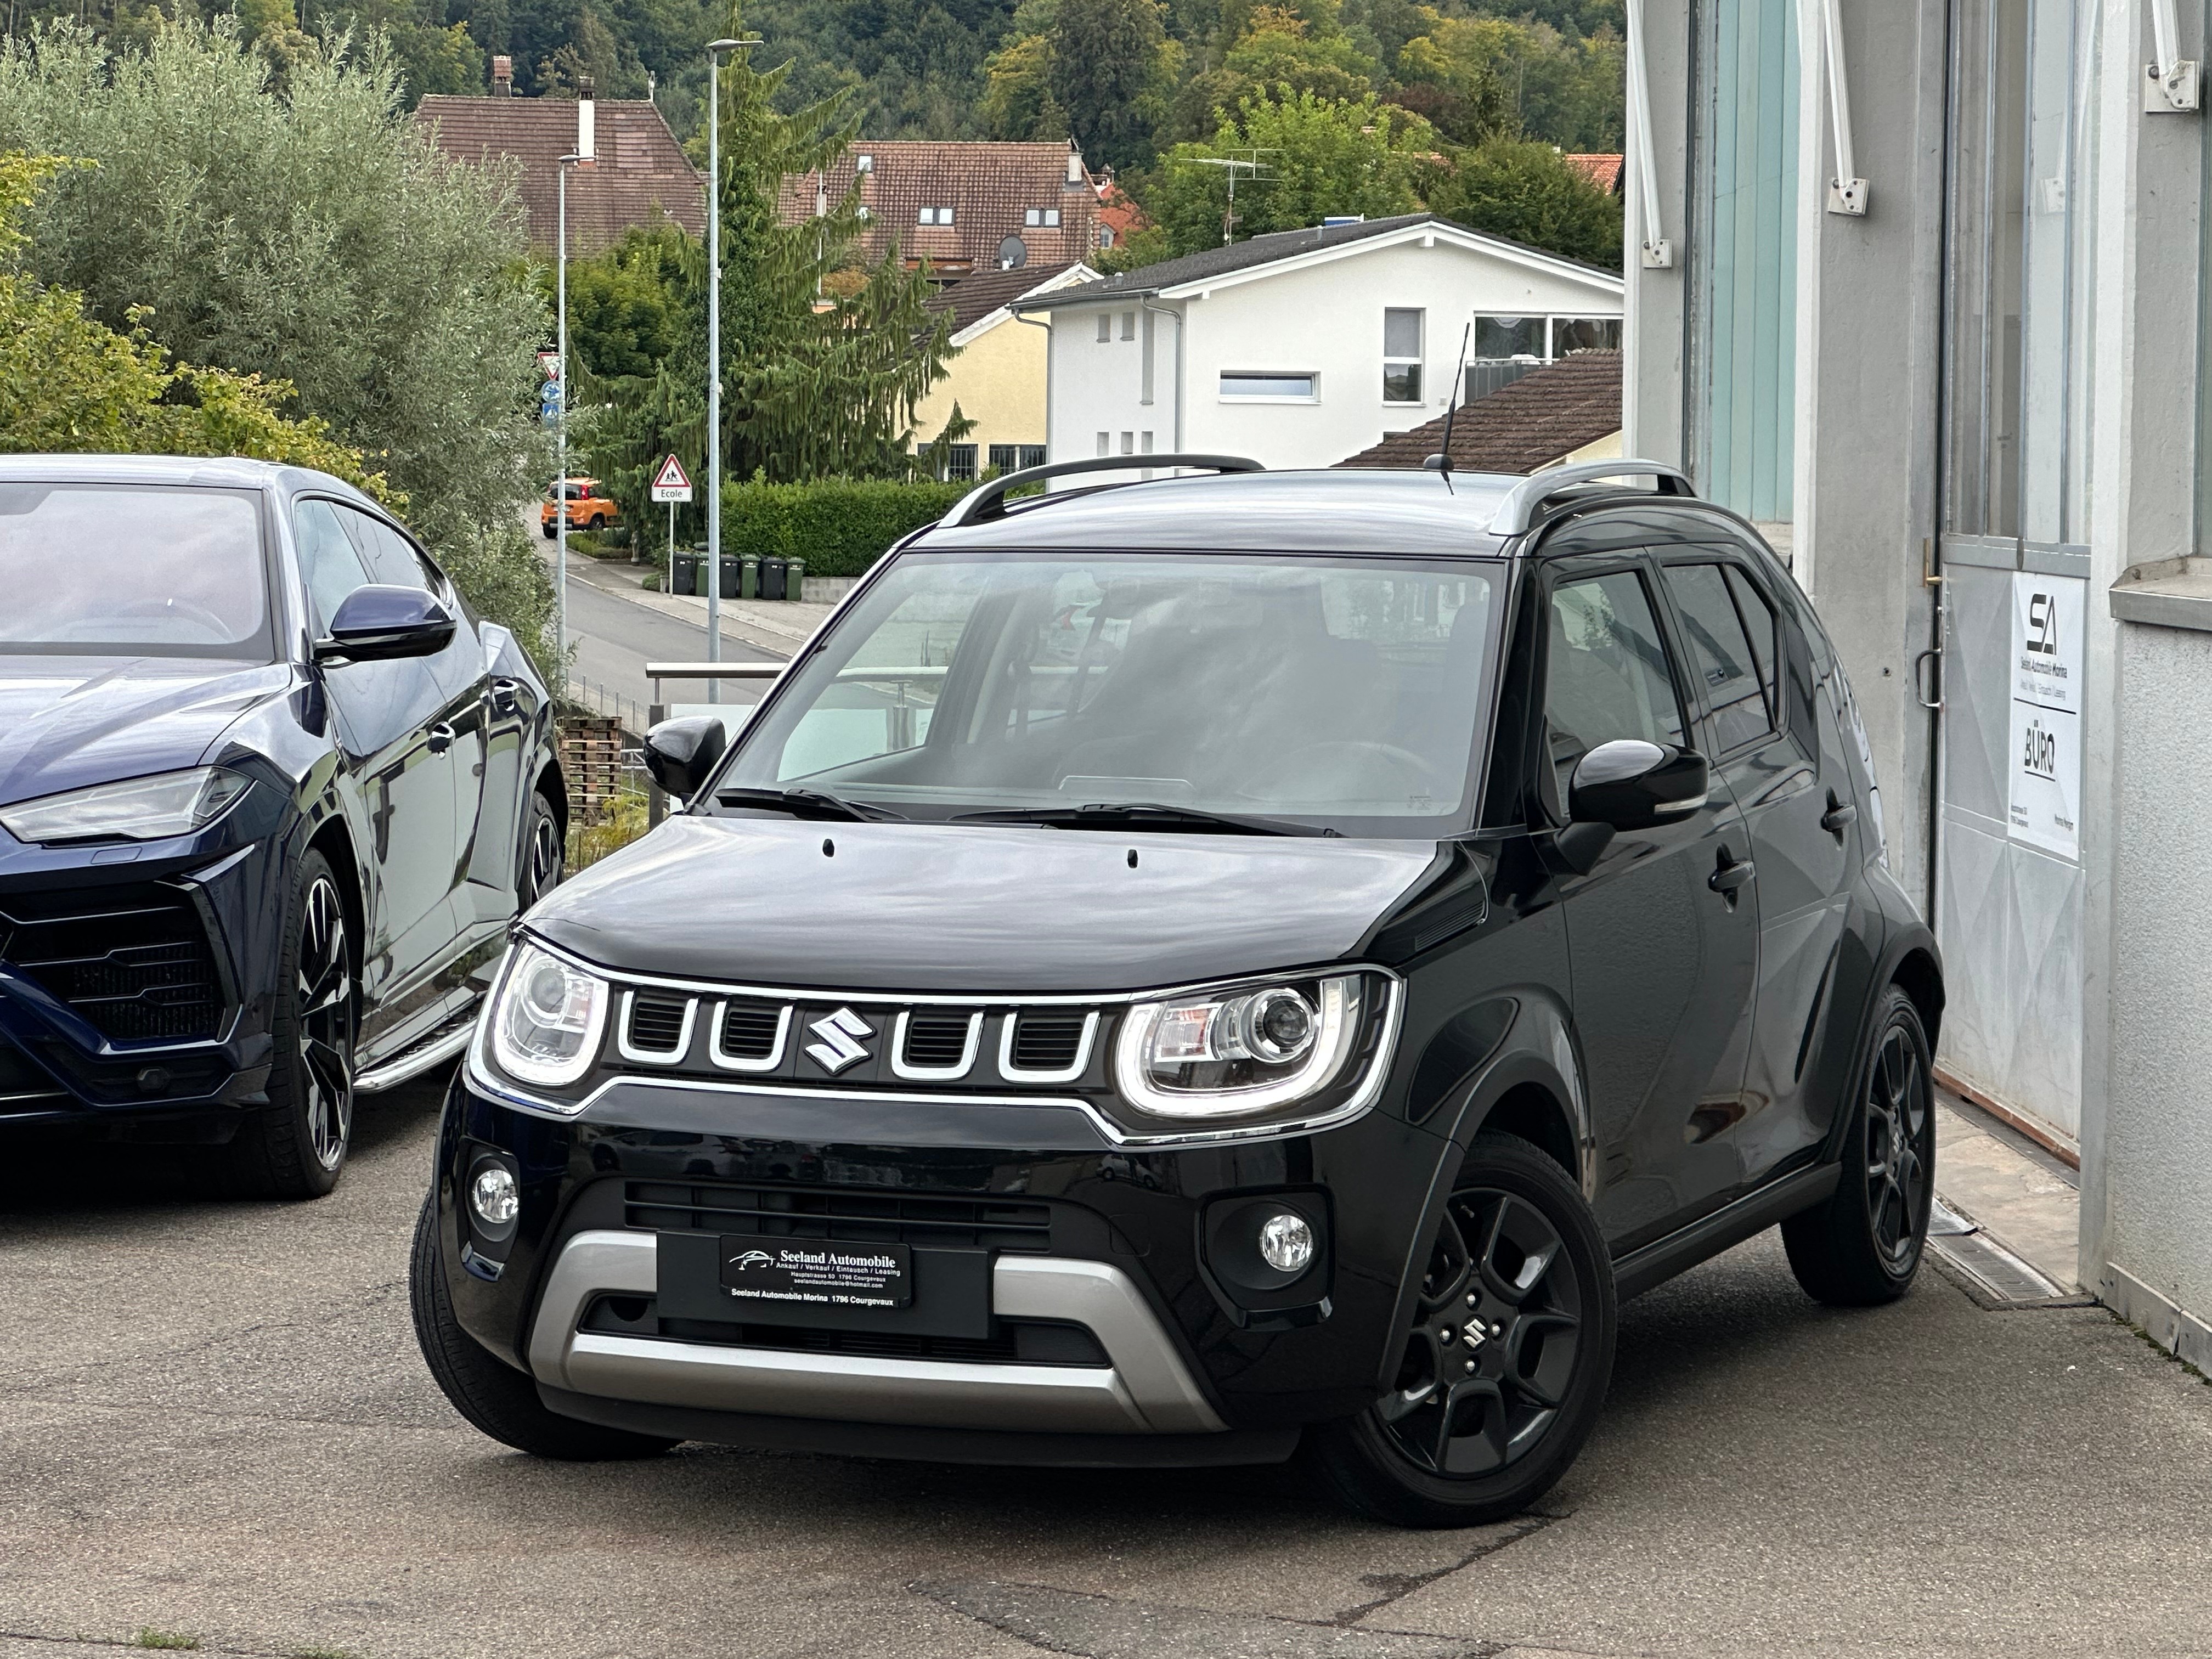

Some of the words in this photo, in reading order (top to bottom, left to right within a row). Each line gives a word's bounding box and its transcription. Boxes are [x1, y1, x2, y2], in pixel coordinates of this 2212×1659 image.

[661, 489, 682, 498] Ecole
[2024, 720, 2056, 774] BÜRO
[781, 1250, 826, 1264] Seeland
[828, 1252, 896, 1268] Automobile
[874, 1268, 901, 1277] Leasing
[731, 1288, 760, 1297] Seeland
[761, 1290, 803, 1301] Automobile
[803, 1293, 828, 1301] Morina
[832, 1295, 849, 1303] 1796
[850, 1295, 894, 1306] Courgevaux
